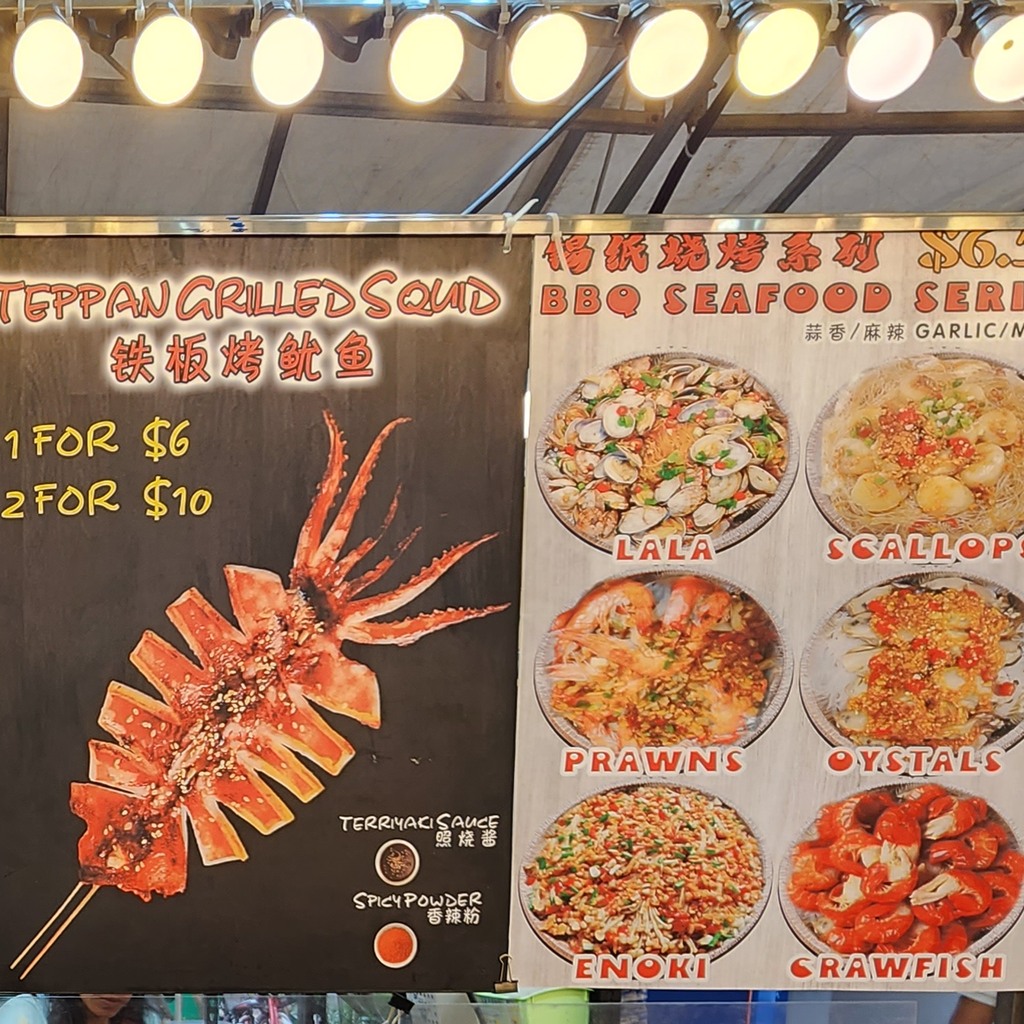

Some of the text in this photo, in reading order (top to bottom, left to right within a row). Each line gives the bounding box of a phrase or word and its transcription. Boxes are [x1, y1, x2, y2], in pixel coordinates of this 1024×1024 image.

[917, 230, 1024, 274] $6.
[176, 275, 356, 321] GRILLED
[360, 270, 502, 320] SQUID
[540, 283, 641, 318] BBQ
[663, 282, 892, 315] SEAFOOD
[804, 322, 905, 341] 蒜香/麻辣
[110, 330, 375, 384] 铁板烤鱿鱼
[3, 415, 191, 463] 1 FOR $6
[0, 475, 213, 520] 2 FOR $10
[613, 536, 715, 561] LALA
[826, 536, 1024, 561] SCALLOP
[563, 749, 744, 773] PRAWNS
[826, 749, 1003, 773] OYSTALS
[339, 813, 500, 832] TERRIYAKI SAUCE
[435, 829, 498, 848] 照烧酱
[352, 891, 483, 909] SPICY POWDER
[426, 907, 481, 925] 香辣粉
[573, 955, 709, 980] ENOKI
[789, 955, 1004, 980] CRAWFISH
